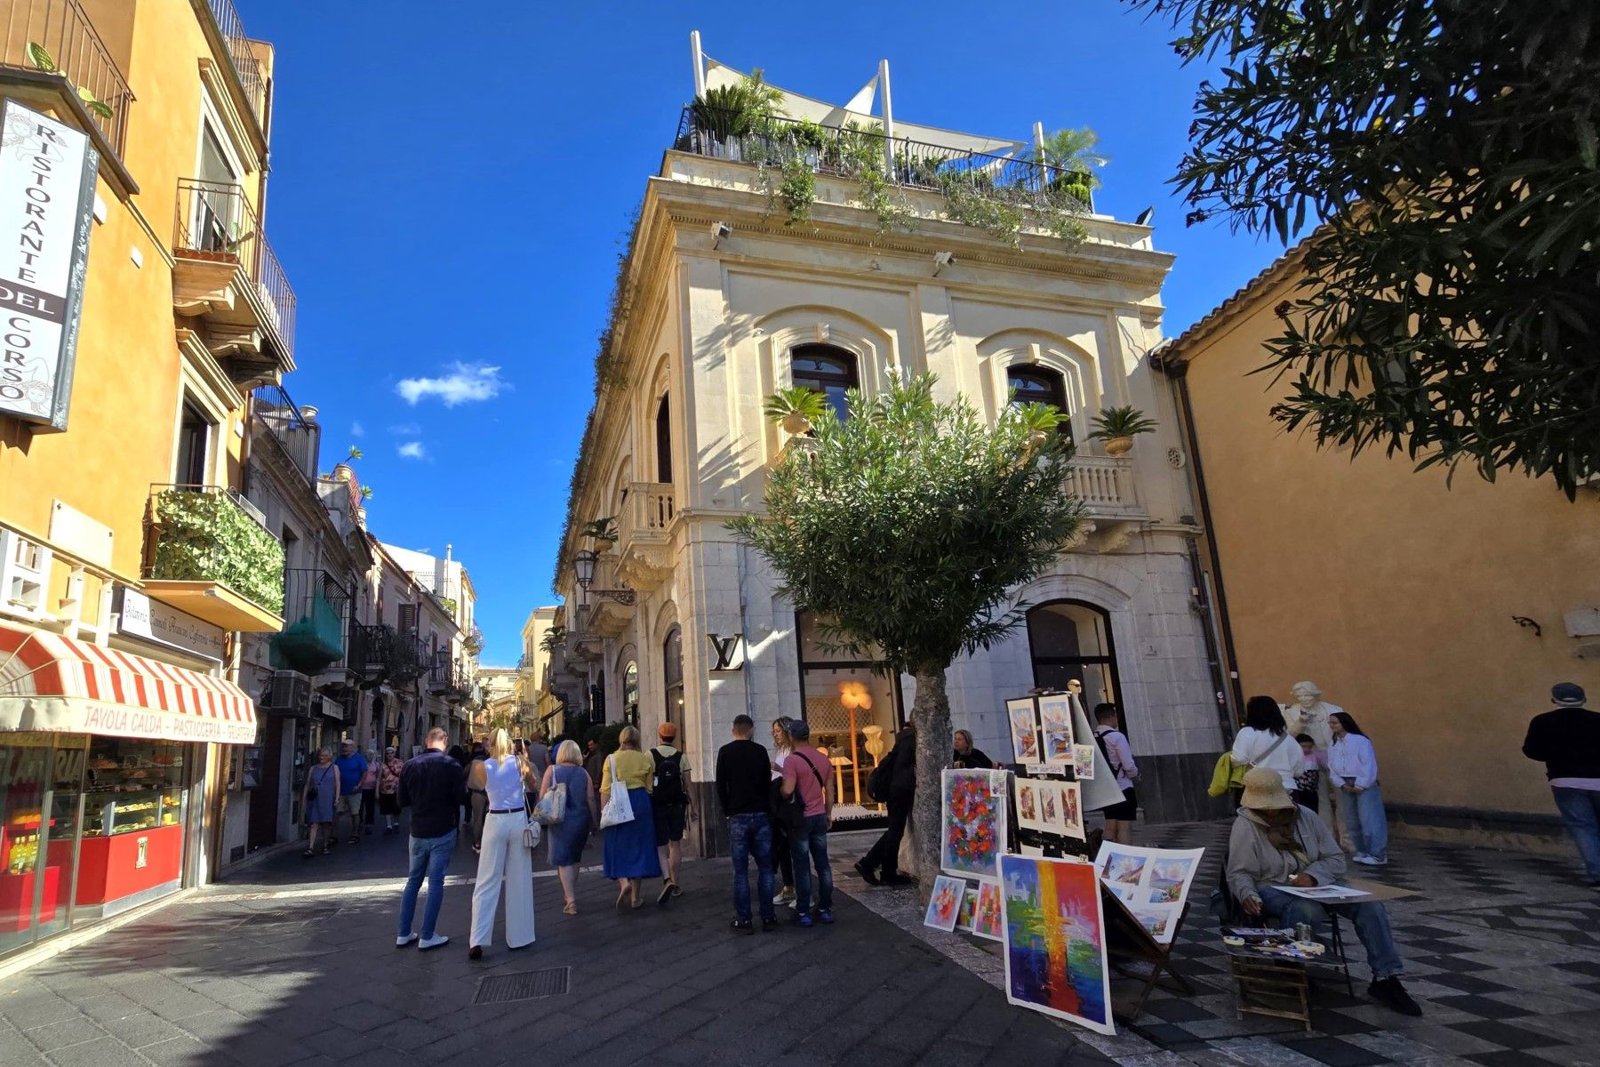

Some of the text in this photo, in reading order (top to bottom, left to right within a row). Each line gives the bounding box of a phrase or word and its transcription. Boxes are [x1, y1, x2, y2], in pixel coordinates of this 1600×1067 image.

[18, 124, 56, 283] RISTORANTE
[0, 286, 55, 315] DEL
[0, 317, 31, 400] CORSO
[706, 633, 745, 672] LV
[83, 705, 127, 730] TAVOLA
[131, 714, 162, 734] CALDA
[173, 718, 221, 739] PASTICCERIA
